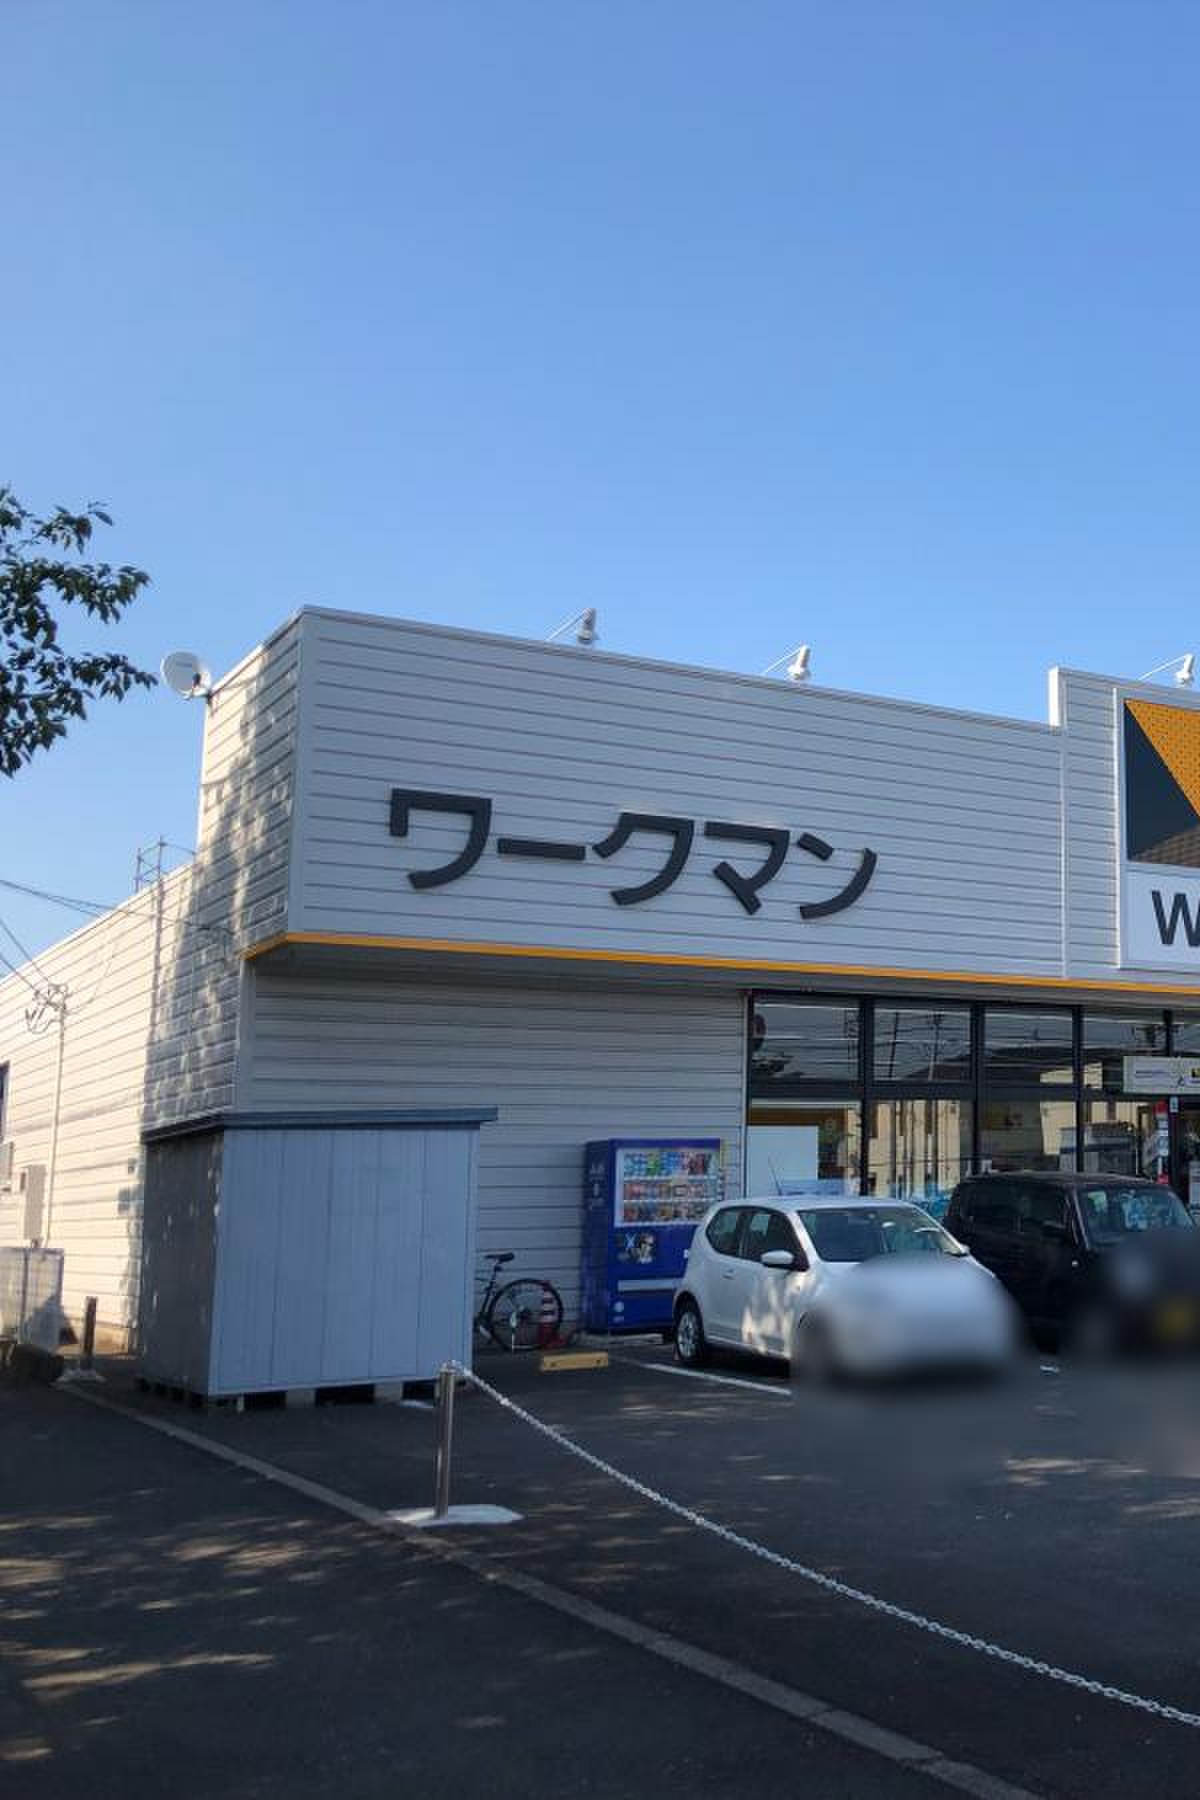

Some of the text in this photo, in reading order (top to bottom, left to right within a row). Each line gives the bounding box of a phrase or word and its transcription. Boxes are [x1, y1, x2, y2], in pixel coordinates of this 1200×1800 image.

[389, 787, 878, 920] ワークマン
